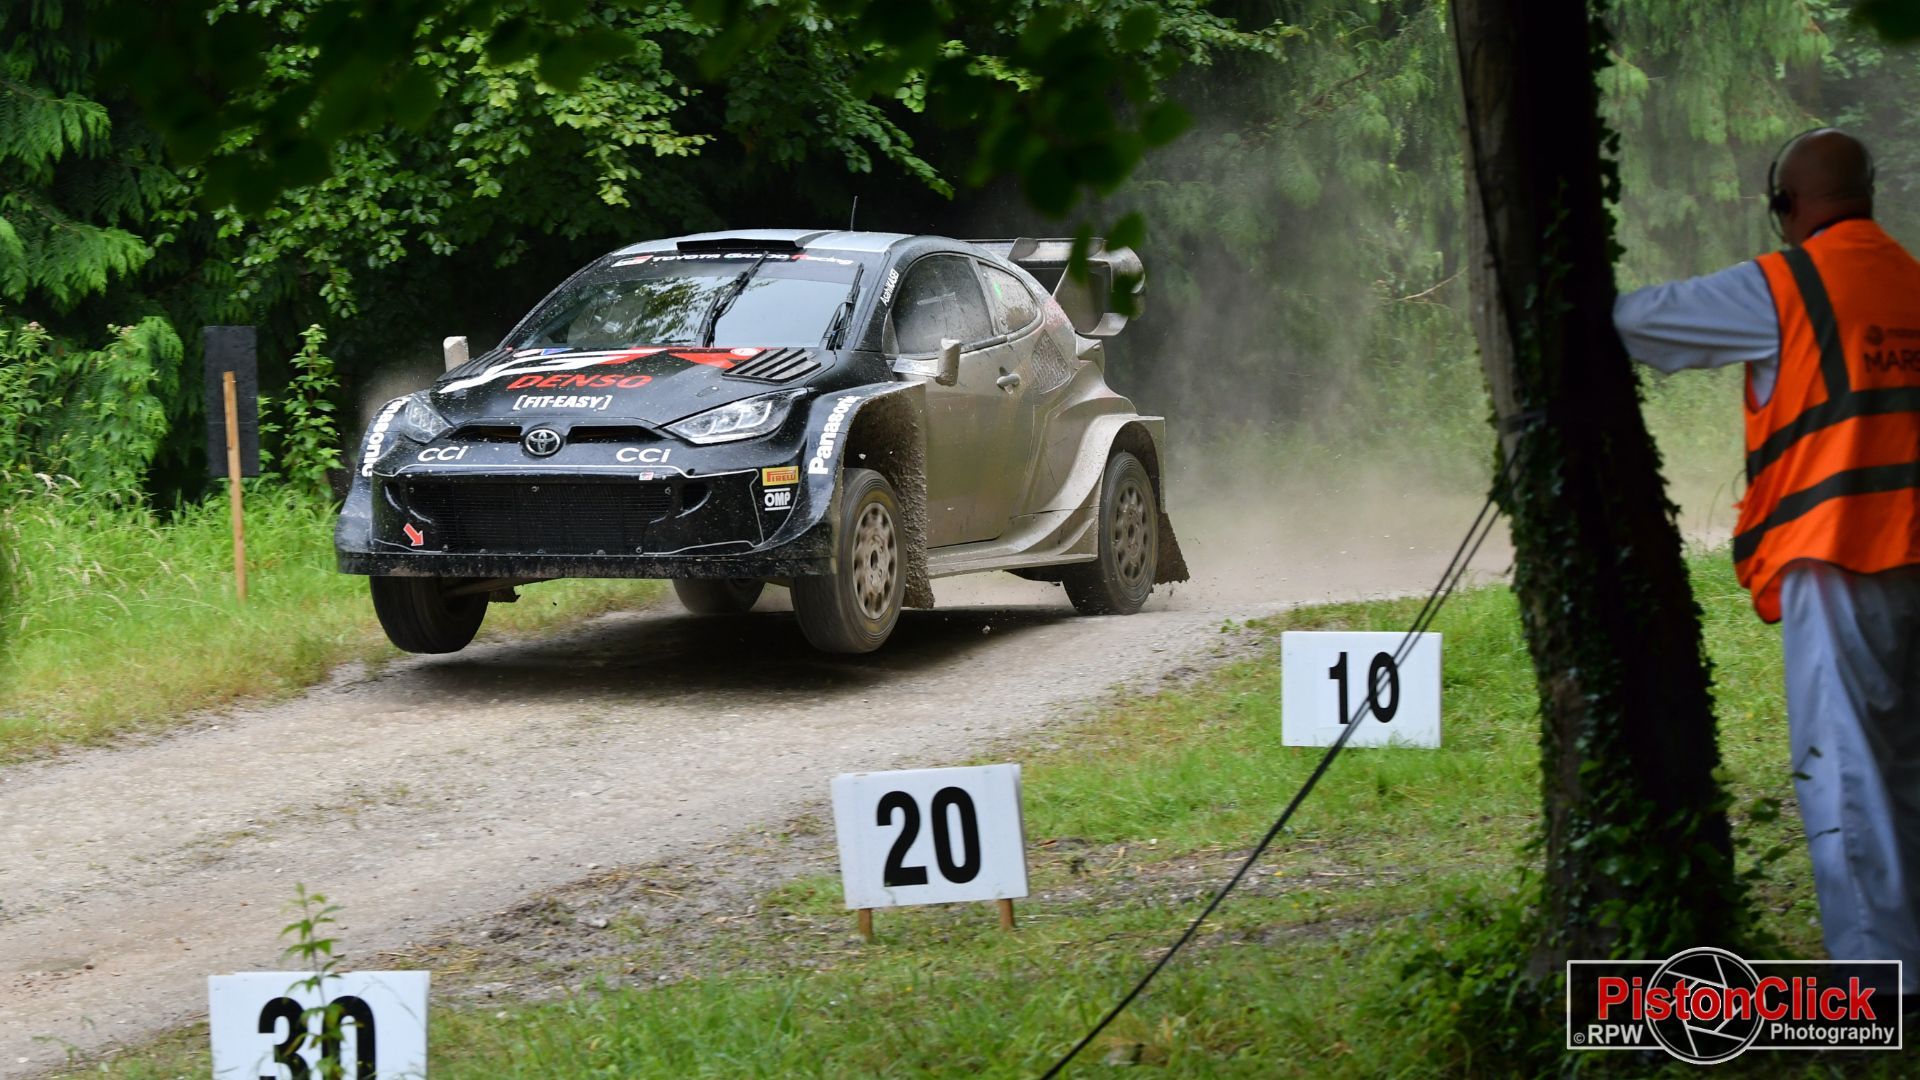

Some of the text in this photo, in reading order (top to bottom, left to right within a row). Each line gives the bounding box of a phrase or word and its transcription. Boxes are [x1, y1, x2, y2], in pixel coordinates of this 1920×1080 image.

[652, 253, 721, 262] TOYOTA
[506, 374, 653, 390] DENSO
[362, 396, 412, 477] anasonic
[807, 395, 861, 475] Panasonic
[764, 491, 791, 507] OMP
[766, 470, 796, 482] PIRELLI
[1328, 652, 1399, 724] 10
[876, 786, 981, 887] 20
[258, 995, 376, 1080] 30
